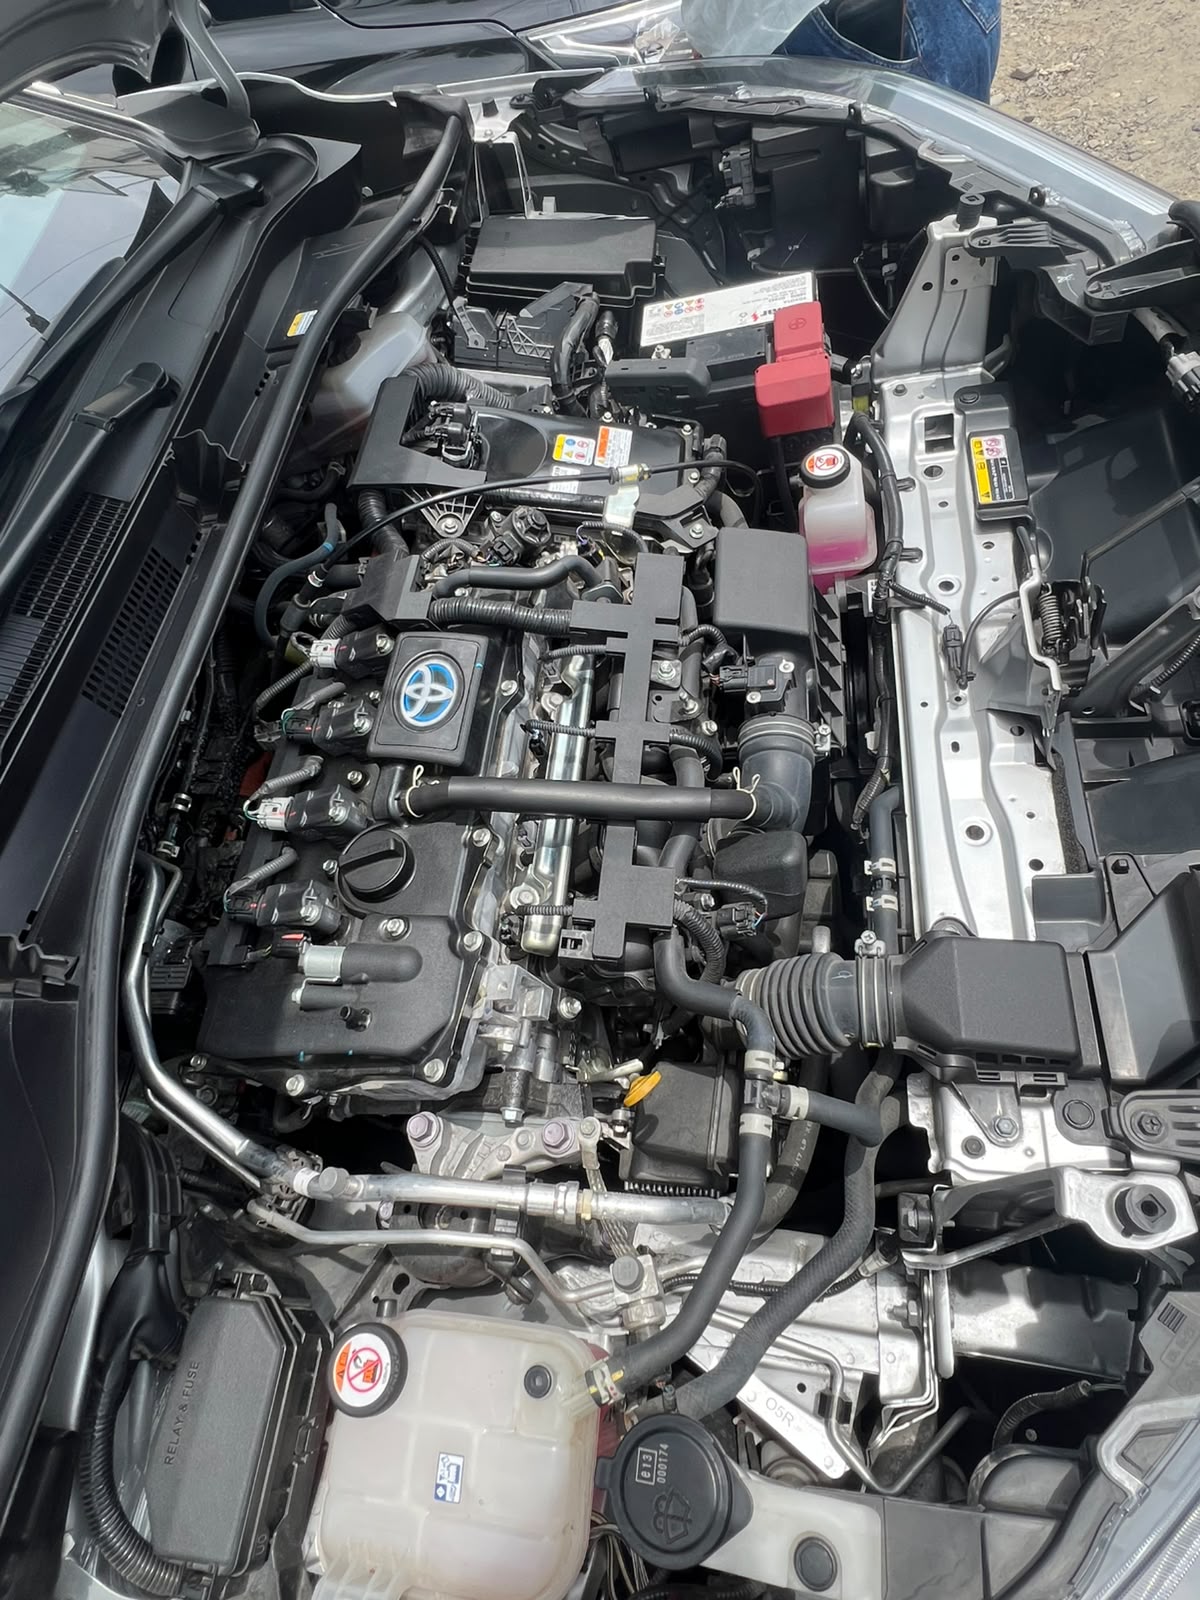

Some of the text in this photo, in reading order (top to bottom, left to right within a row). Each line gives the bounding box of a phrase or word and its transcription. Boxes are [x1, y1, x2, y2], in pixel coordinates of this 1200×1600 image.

[163, 1360, 200, 1465] RELAY & FUSE
[640, 1454, 653, 1479] e13
[656, 1443, 670, 1484] 000174
